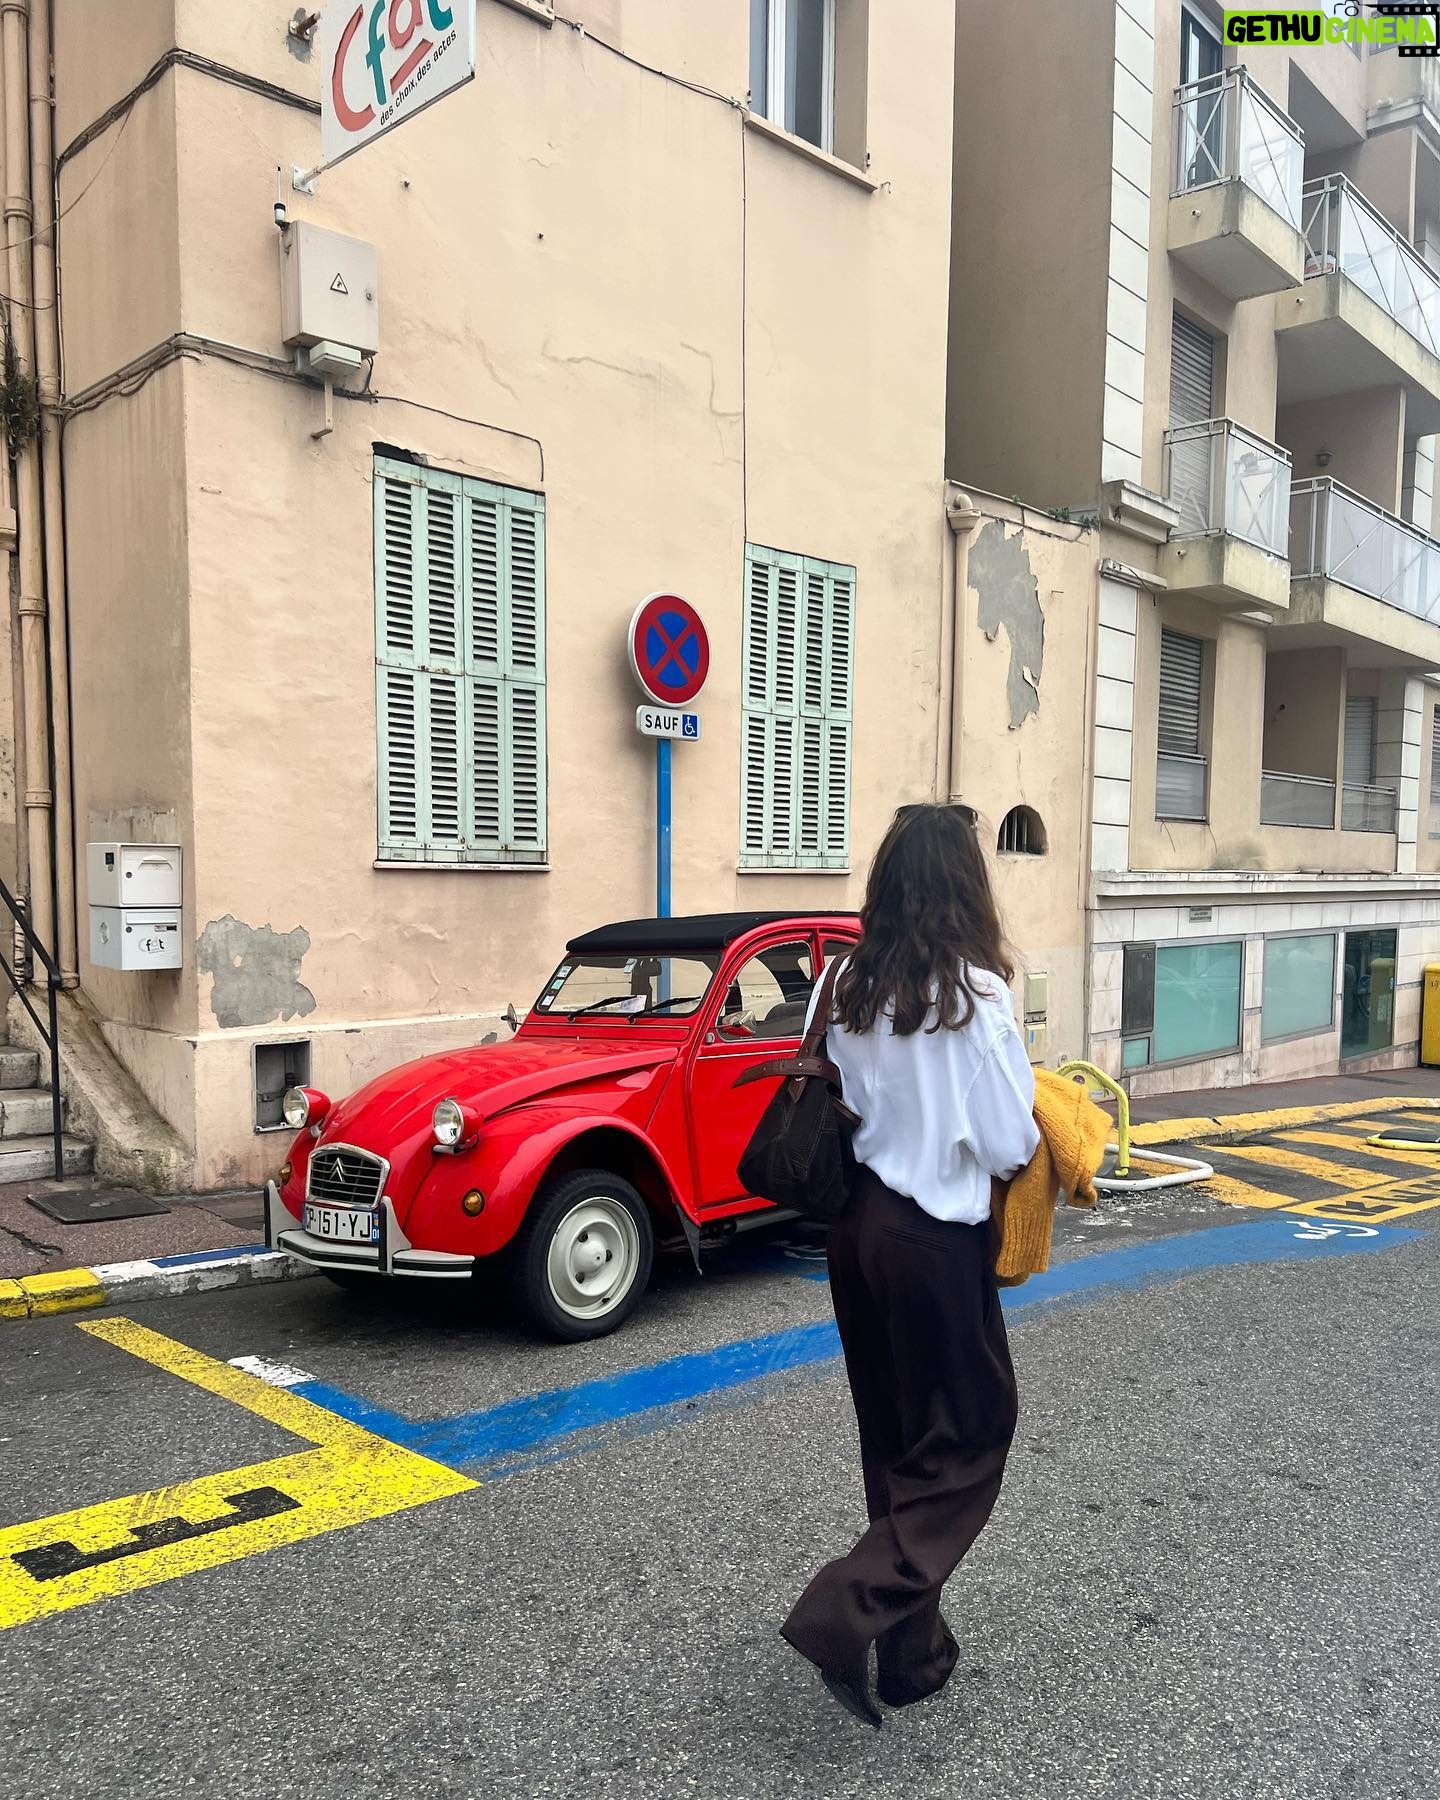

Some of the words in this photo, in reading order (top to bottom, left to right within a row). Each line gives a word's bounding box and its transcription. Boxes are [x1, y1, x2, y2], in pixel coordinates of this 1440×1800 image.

[380, 106, 394, 126] des
[433, 29, 457, 62] actes
[645, 714, 679, 731] SAUF
